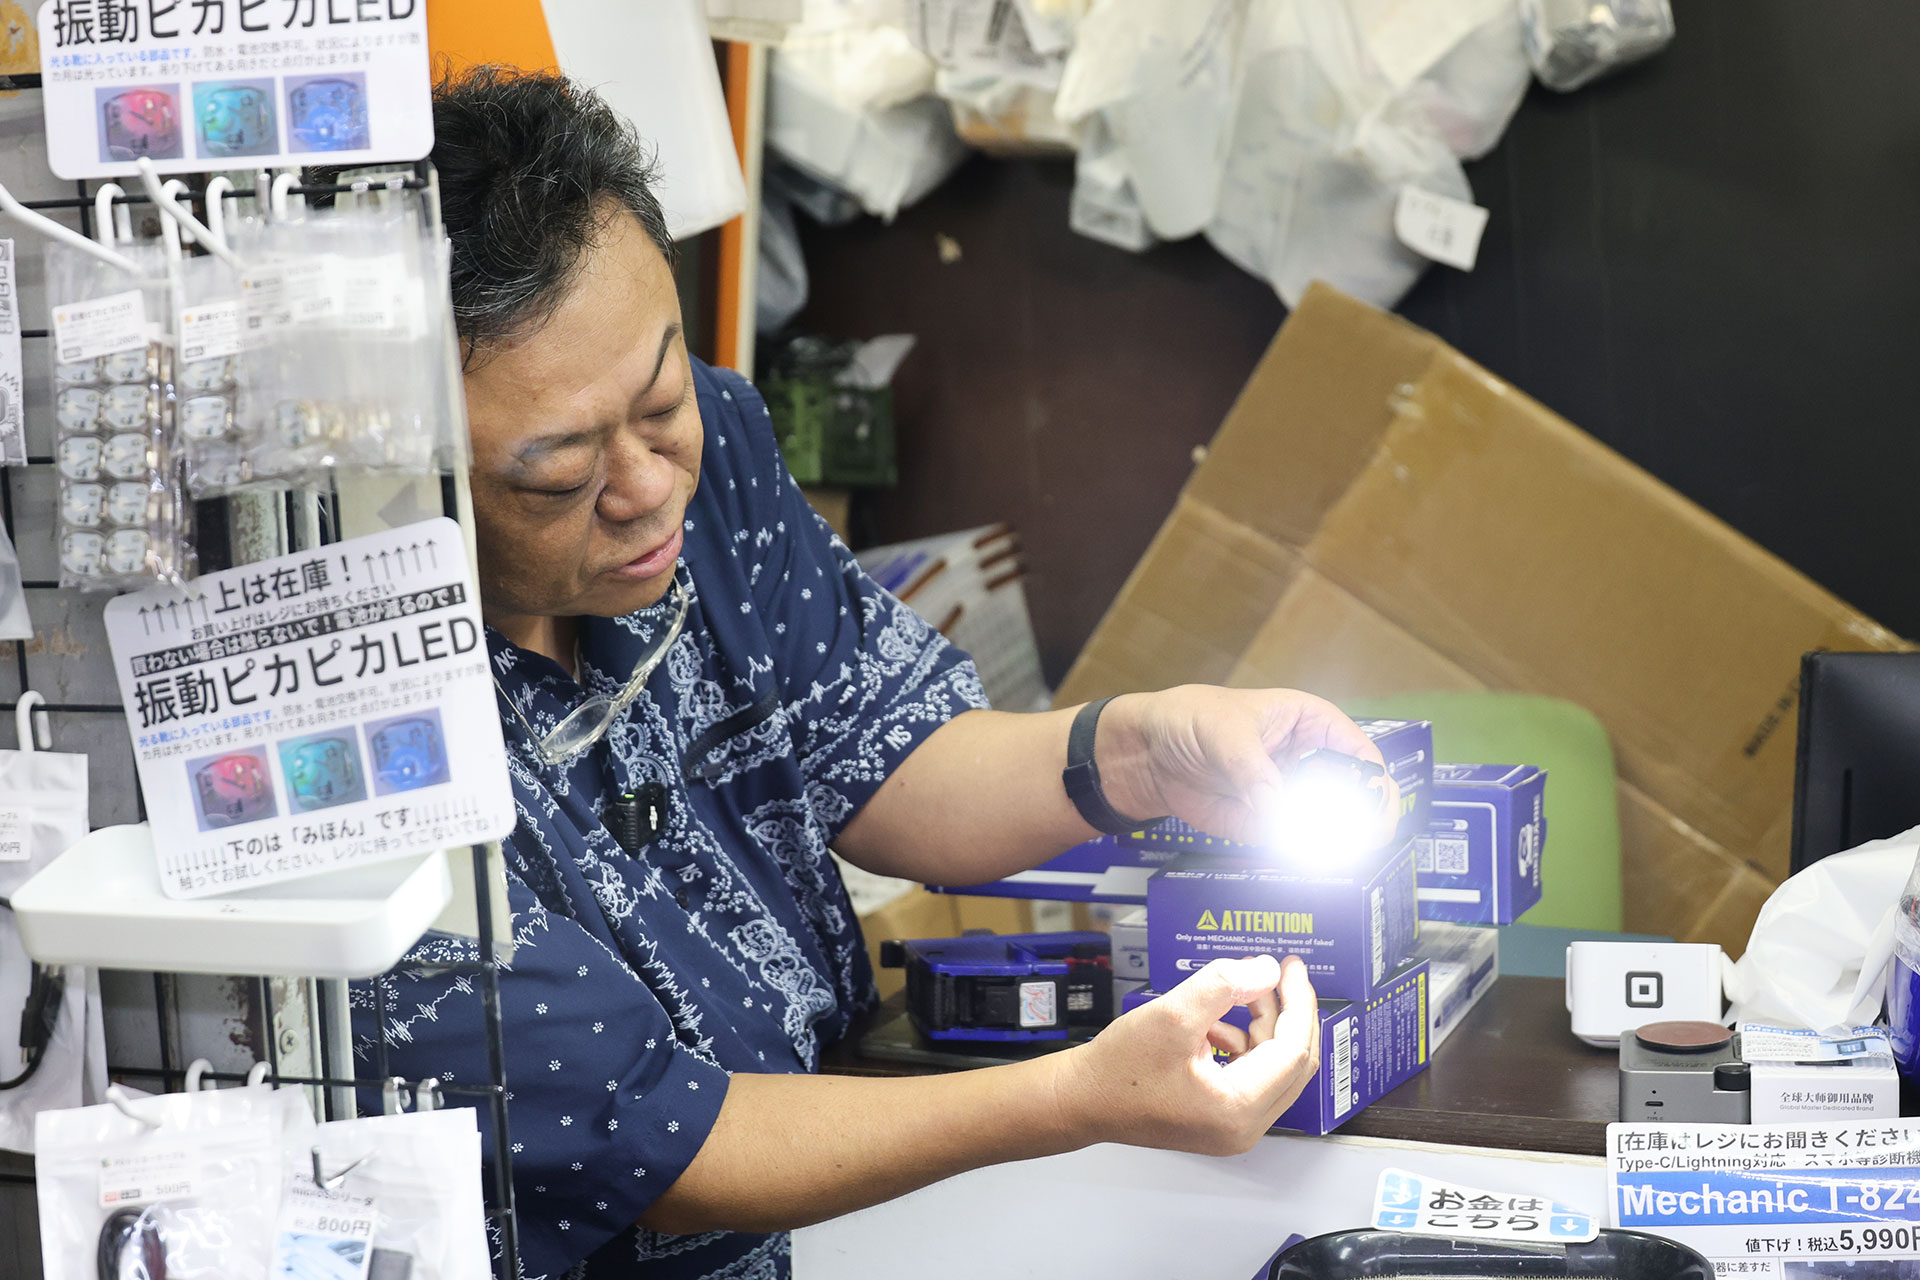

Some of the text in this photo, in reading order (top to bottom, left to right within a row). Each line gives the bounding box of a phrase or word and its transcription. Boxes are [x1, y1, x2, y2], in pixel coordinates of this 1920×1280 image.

[214, 556, 352, 616] 上は在庫！
[191, 583, 396, 641] お買い上げはレジにお持ちください
[134, 616, 478, 728] 振動ピカピカLED
[228, 806, 412, 858] 下のは「みほん」です
[1221, 910, 1313, 934] ATTENTION
[1176, 933, 1192, 942] Only
[1208, 935, 1245, 943] MECHANIC
[1278, 938, 1303, 946] Beware
[1314, 938, 1334, 946] fakes!
[1780, 1091, 1874, 1104] 全球大师御用品牌
[1429, 1188, 1543, 1212] お金は
[1623, 1183, 1809, 1216] Mechanic
[1427, 1214, 1539, 1231] こちら
